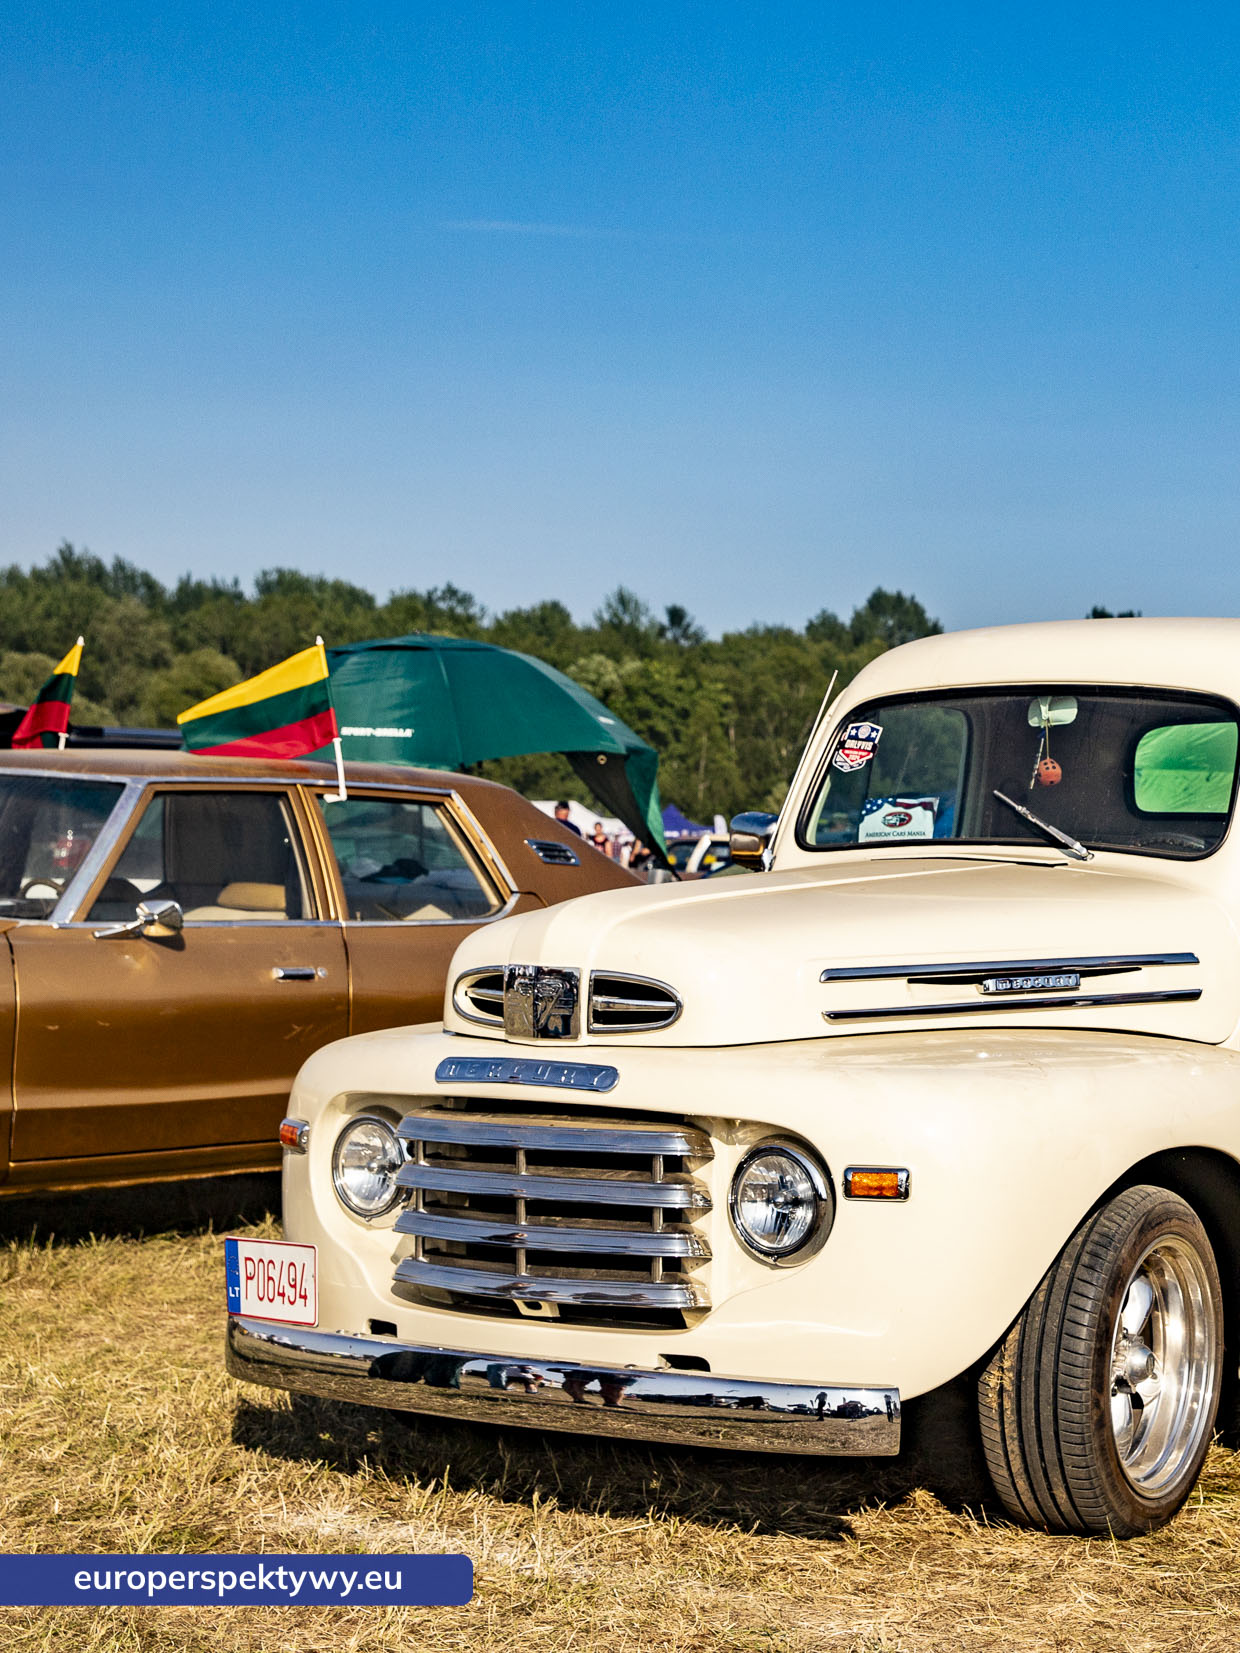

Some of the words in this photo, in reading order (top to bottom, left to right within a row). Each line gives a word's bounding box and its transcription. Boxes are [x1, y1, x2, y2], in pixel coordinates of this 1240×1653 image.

[996, 976, 1077, 991] MERCURY
[445, 1063, 611, 1087] MERCURY
[244, 1256, 308, 1308] P06494
[229, 1286, 240, 1298] LT
